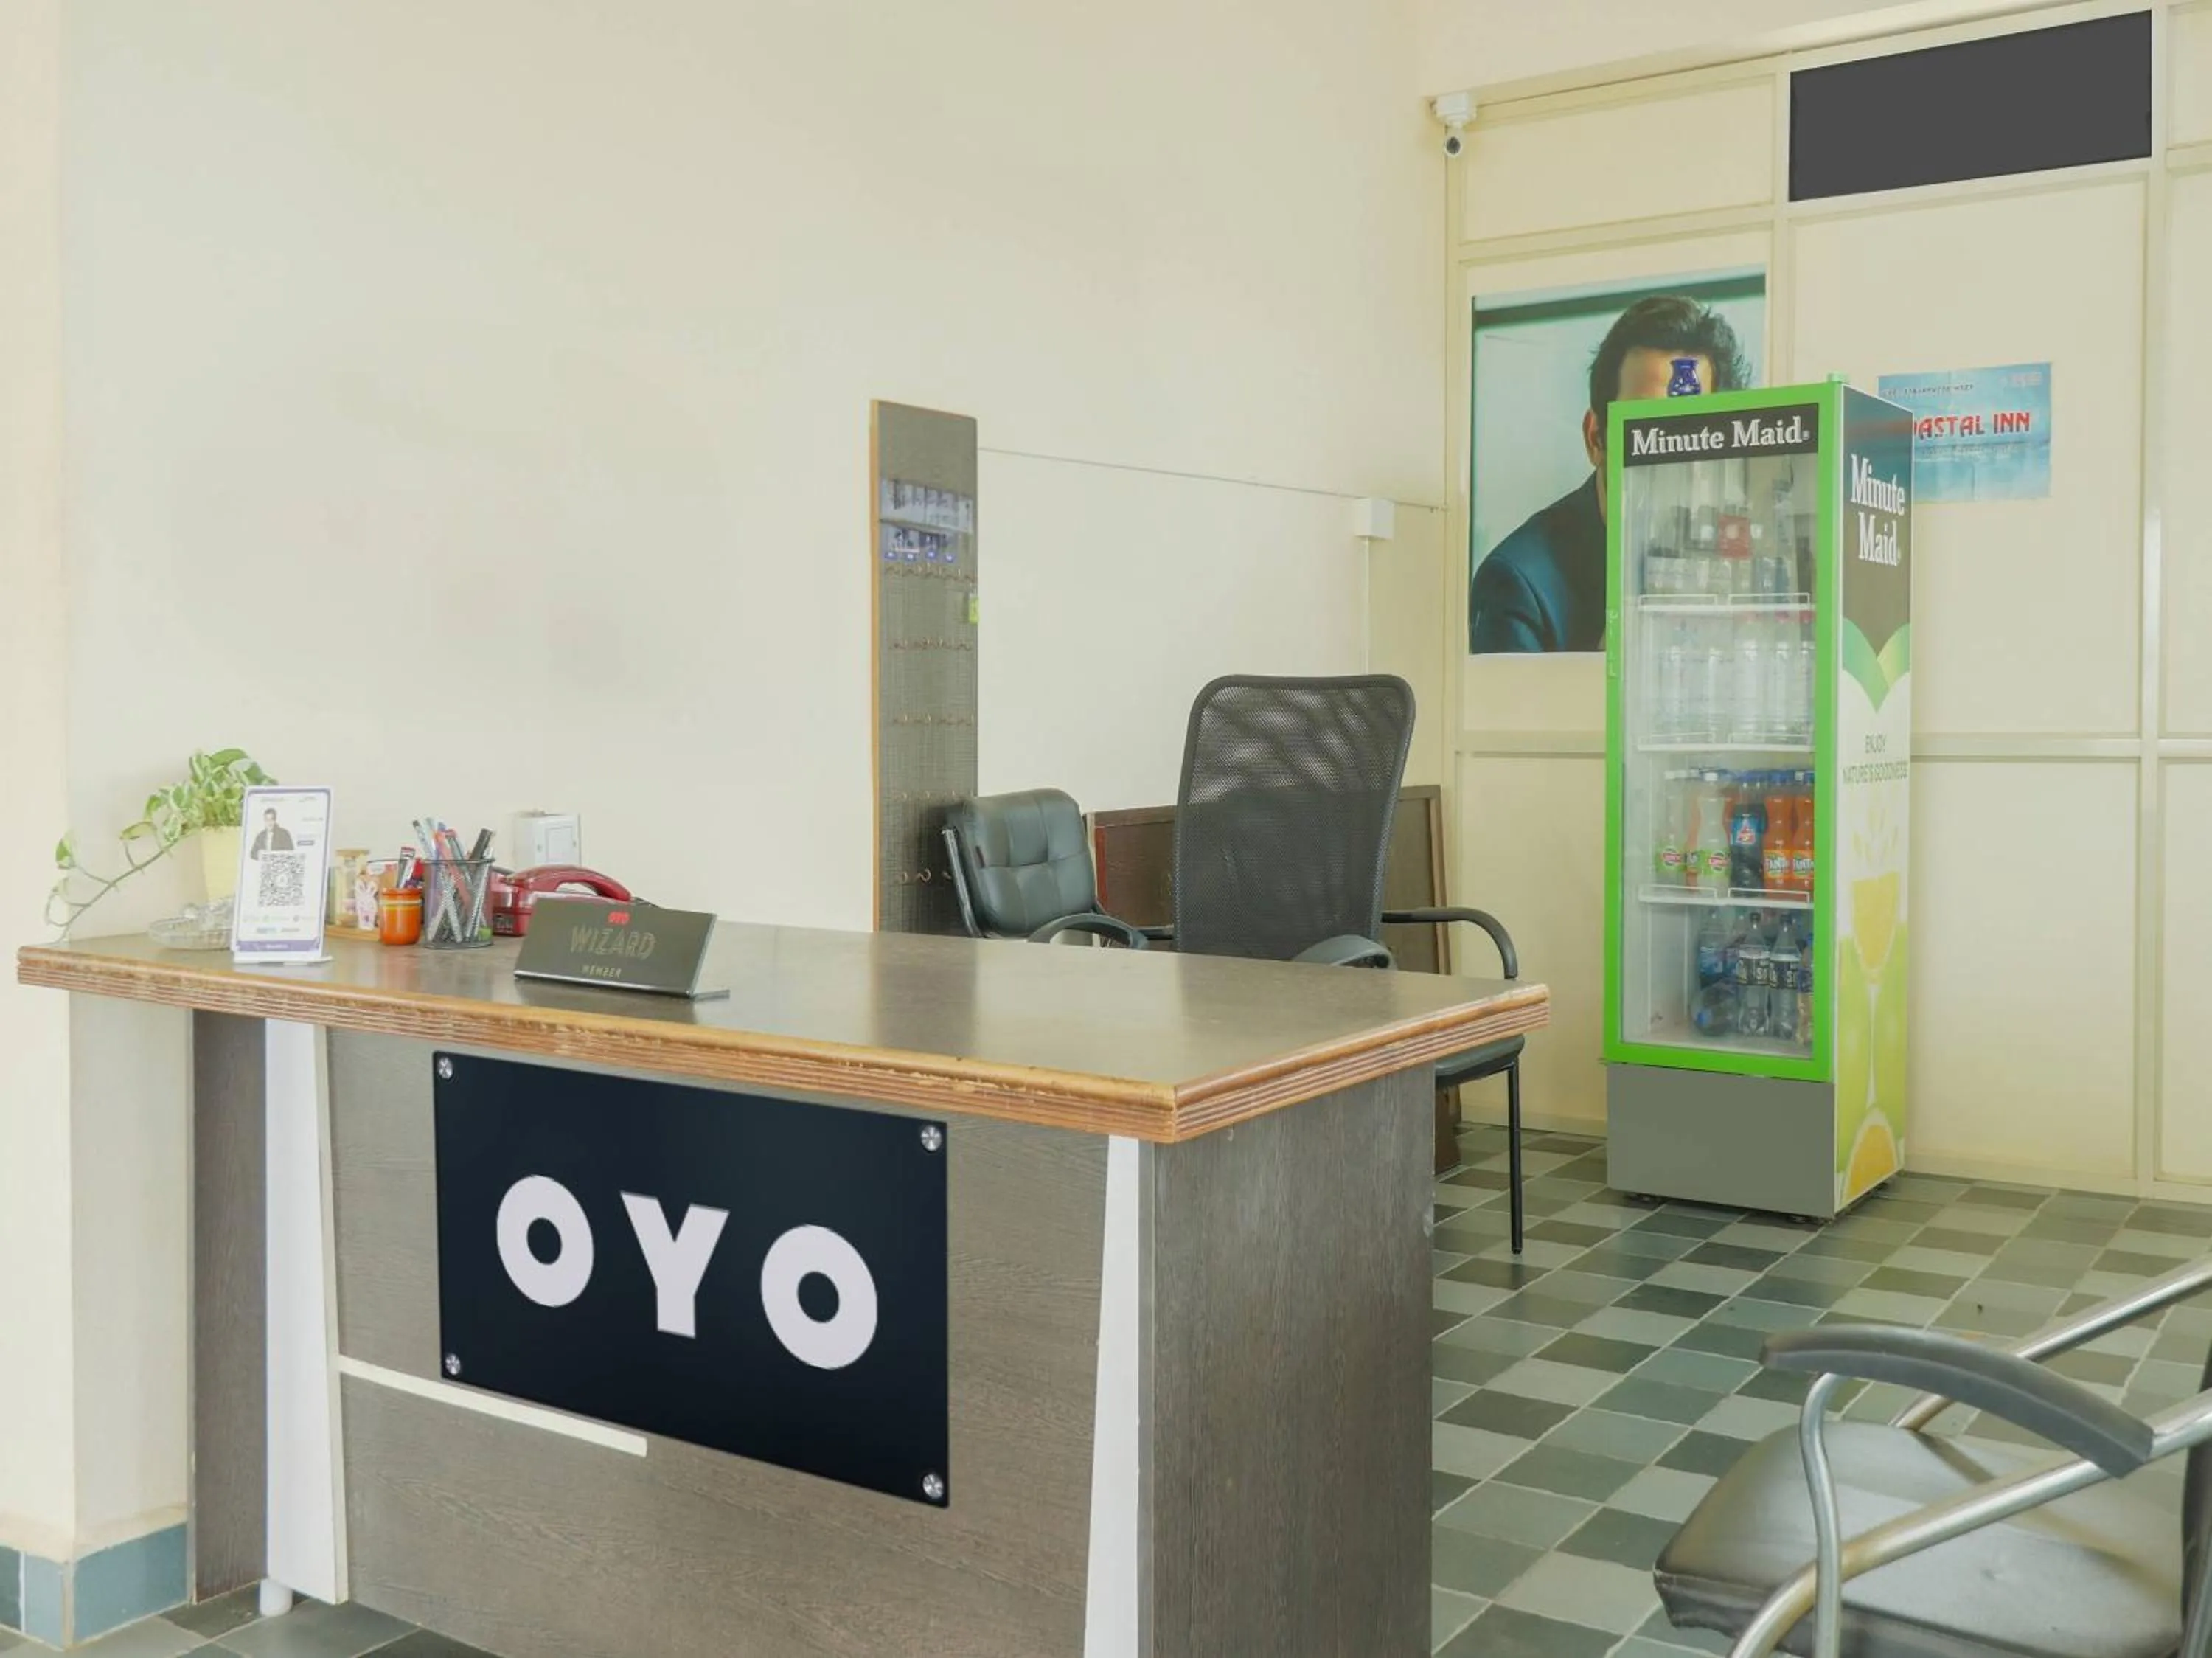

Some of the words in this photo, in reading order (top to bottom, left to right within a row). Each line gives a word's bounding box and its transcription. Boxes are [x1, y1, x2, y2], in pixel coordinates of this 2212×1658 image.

[1631, 426, 1725, 456] Minute
[1731, 415, 1804, 448] Maid
[1993, 412, 2030, 434] INN
[1850, 454, 1905, 516] Minute
[1858, 511, 1898, 566] Maid
[571, 926, 656, 959] WIZARD
[582, 964, 622, 978] MEMBER
[495, 1174, 878, 1370] OYO
